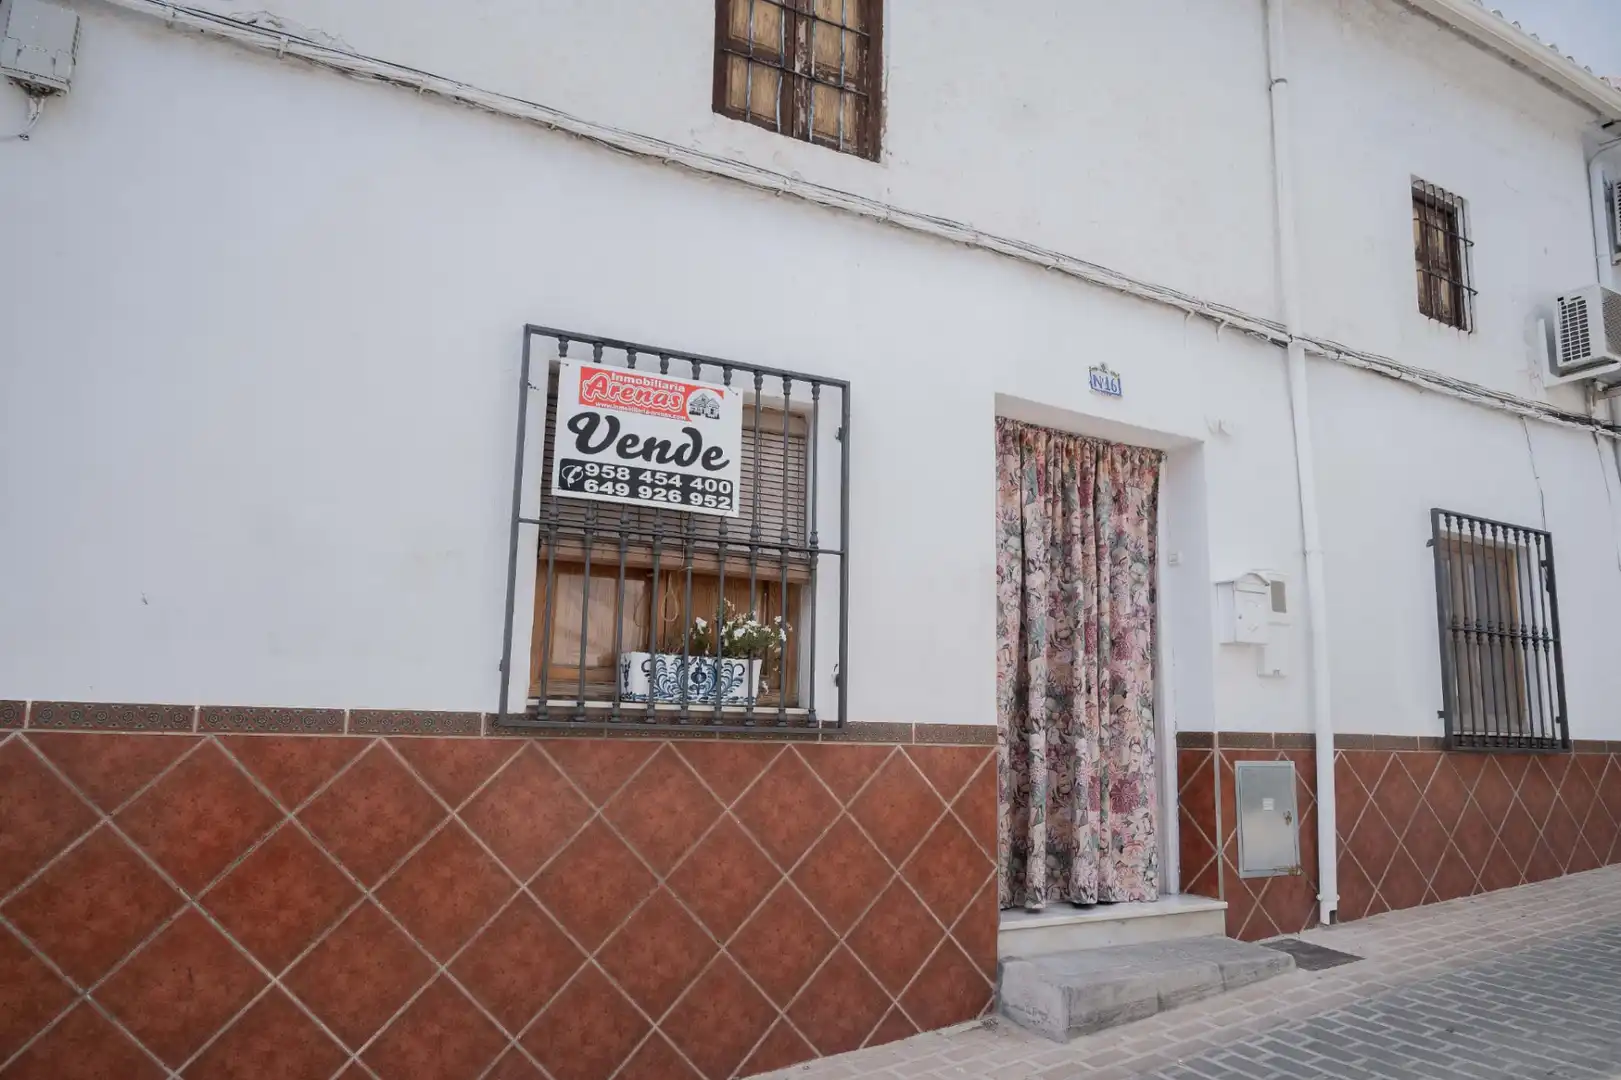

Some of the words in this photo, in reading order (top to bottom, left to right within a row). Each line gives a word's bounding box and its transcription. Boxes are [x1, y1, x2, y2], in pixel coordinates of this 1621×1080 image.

[582, 372, 684, 412] Arenas
[611, 372, 686, 392] Inmobiliaria
[567, 411, 730, 471] Vende
[583, 479, 630, 497] 649
[638, 487, 682, 503] 926
[689, 492, 731, 509] 952
[584, 463, 630, 481] 958
[639, 471, 682, 487] 454
[690, 478, 732, 494] 400
